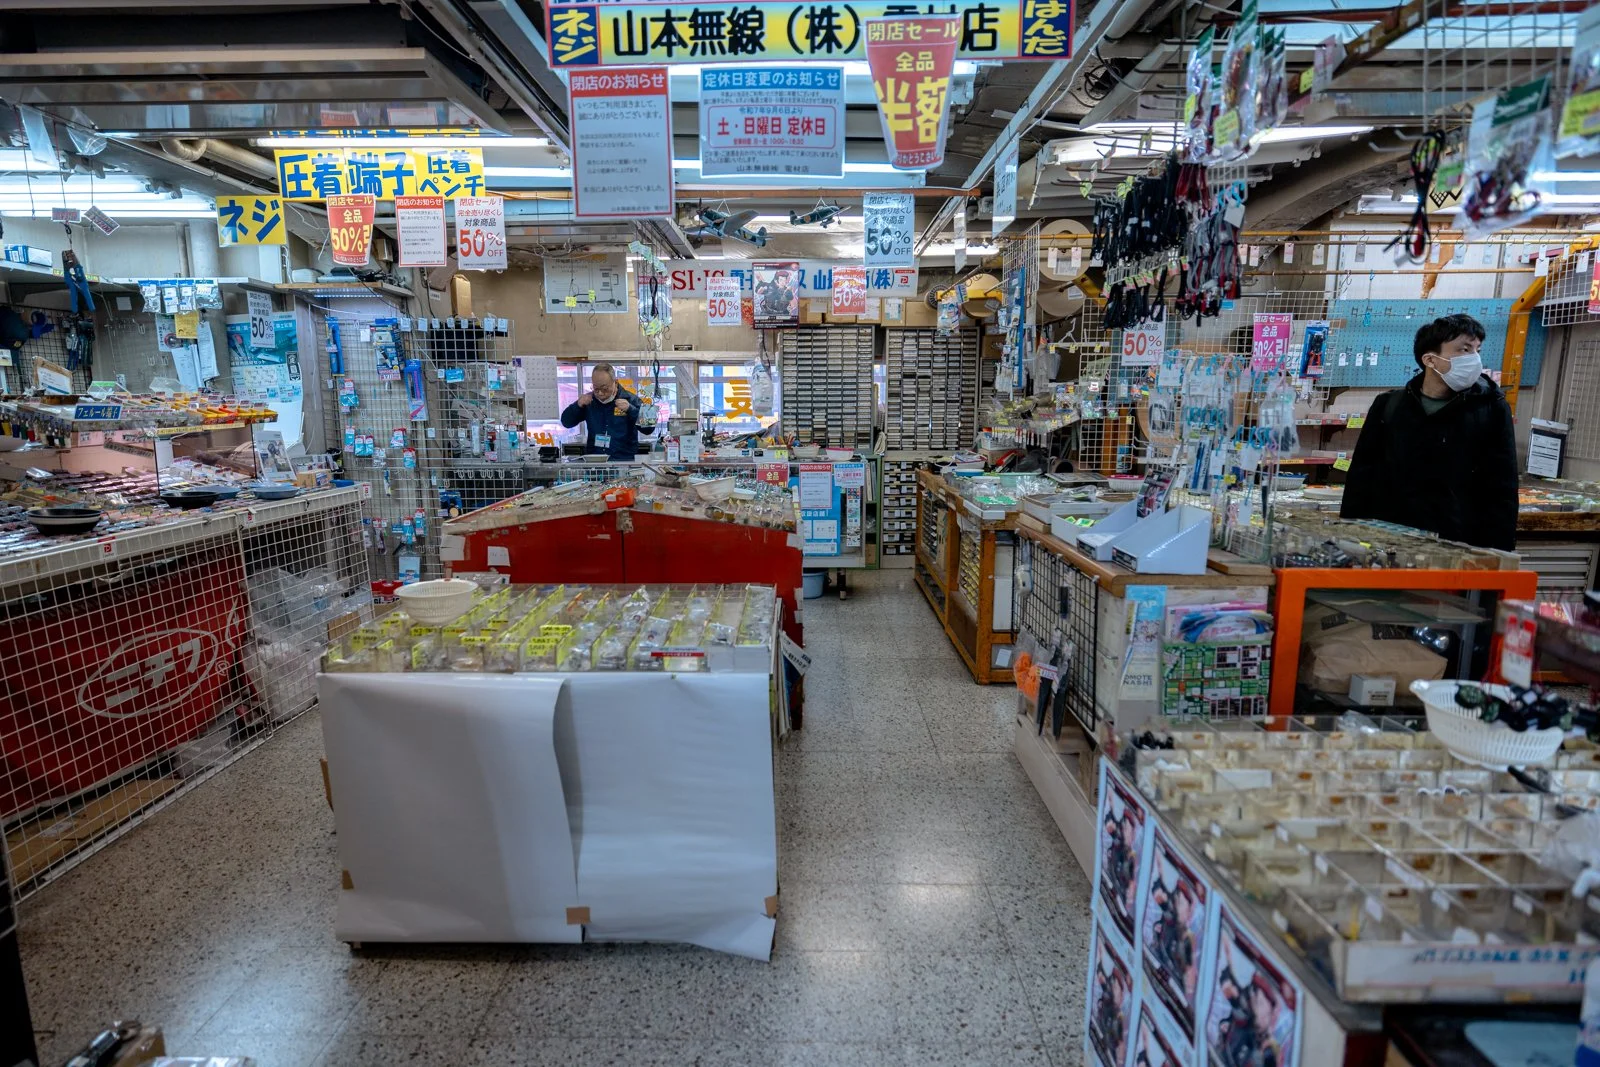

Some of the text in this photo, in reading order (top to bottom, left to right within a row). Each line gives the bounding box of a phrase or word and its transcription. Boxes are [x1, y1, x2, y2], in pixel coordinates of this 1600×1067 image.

[553, 9, 596, 62] ネジ
[613, 2, 999, 56] 山本無線（株）店
[867, 22, 960, 42] 閉店セール
[1024, 0, 1066, 54] はんだ
[896, 51, 934, 72] 全品
[571, 73, 665, 91] 閉店のお知らせ
[704, 71, 839, 87] 定休日変更のお知らせ
[717, 117, 826, 136] 土・日曜日 定休日
[279, 150, 471, 199] 圧着端子 圧着
[420, 174, 484, 197] ペンチ
[218, 199, 282, 242] ネジ
[343, 209, 363, 224] 全品
[464, 218, 497, 227] 対象商品
[487, 249, 504, 257] OFF
[894, 247, 911, 256] OFF
[1590, 280, 1600, 301] 5
[709, 298, 739, 318] 50%
[251, 316, 274, 339] 50%
[1261, 325, 1278, 337] 全品
[1123, 332, 1162, 356] 50%
[766, 471, 780, 481] 全品
